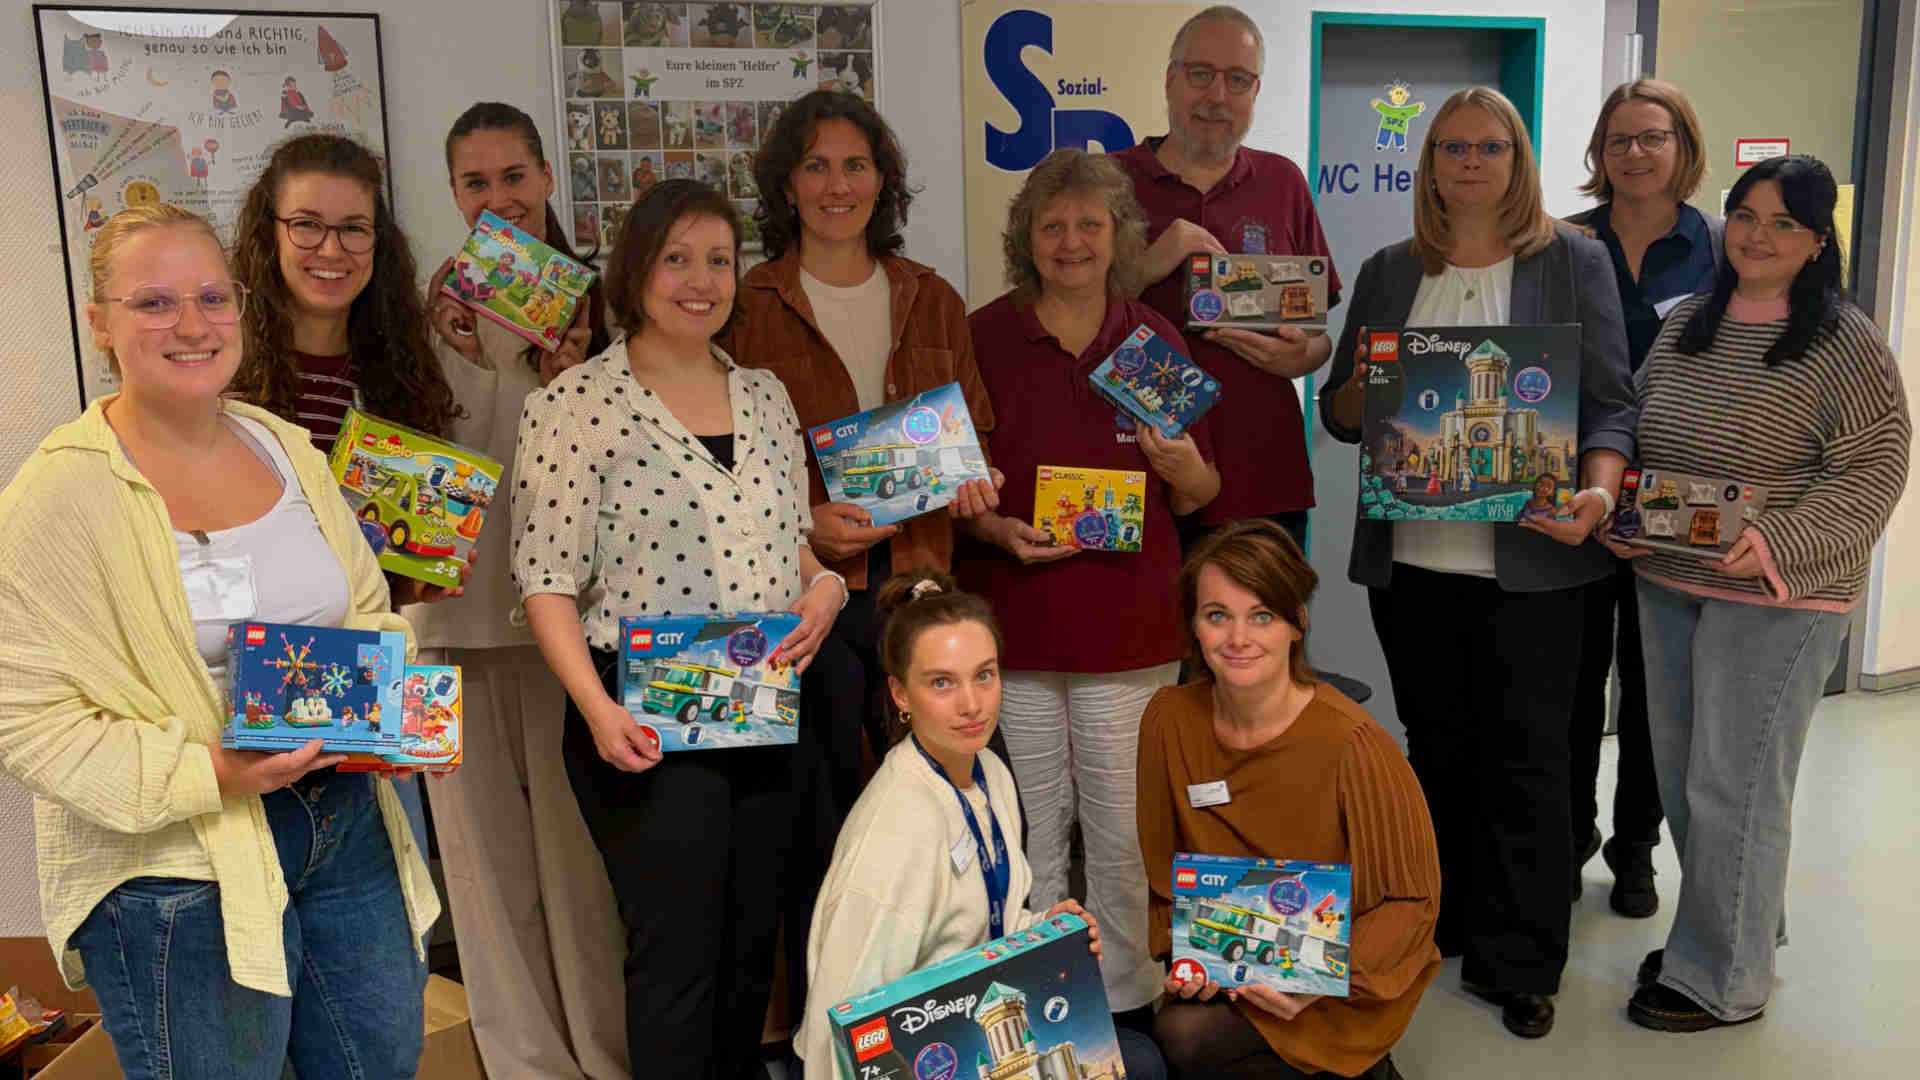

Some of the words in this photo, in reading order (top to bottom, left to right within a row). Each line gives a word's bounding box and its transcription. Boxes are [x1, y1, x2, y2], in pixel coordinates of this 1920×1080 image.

[216, 25, 241, 40] und
[143, 42, 185, 56] genau
[192, 42, 209, 54] so
[214, 41, 240, 55] wie
[242, 41, 260, 55] ich
[266, 42, 288, 55] bin
[665, 60, 692, 71] Eure
[695, 59, 736, 71] kleinen
[705, 76, 720, 88] im
[722, 78, 744, 88] SPZ
[1057, 77, 1108, 95] Sozial-
[1318, 163, 1359, 193] WC
[1374, 163, 1417, 192] He
[1369, 365, 1384, 376] 7+
[836, 422, 859, 439] CITY
[657, 632, 685, 645] CITY
[1201, 874, 1229, 886] CITY
[857, 1028, 886, 1050] LEGO
